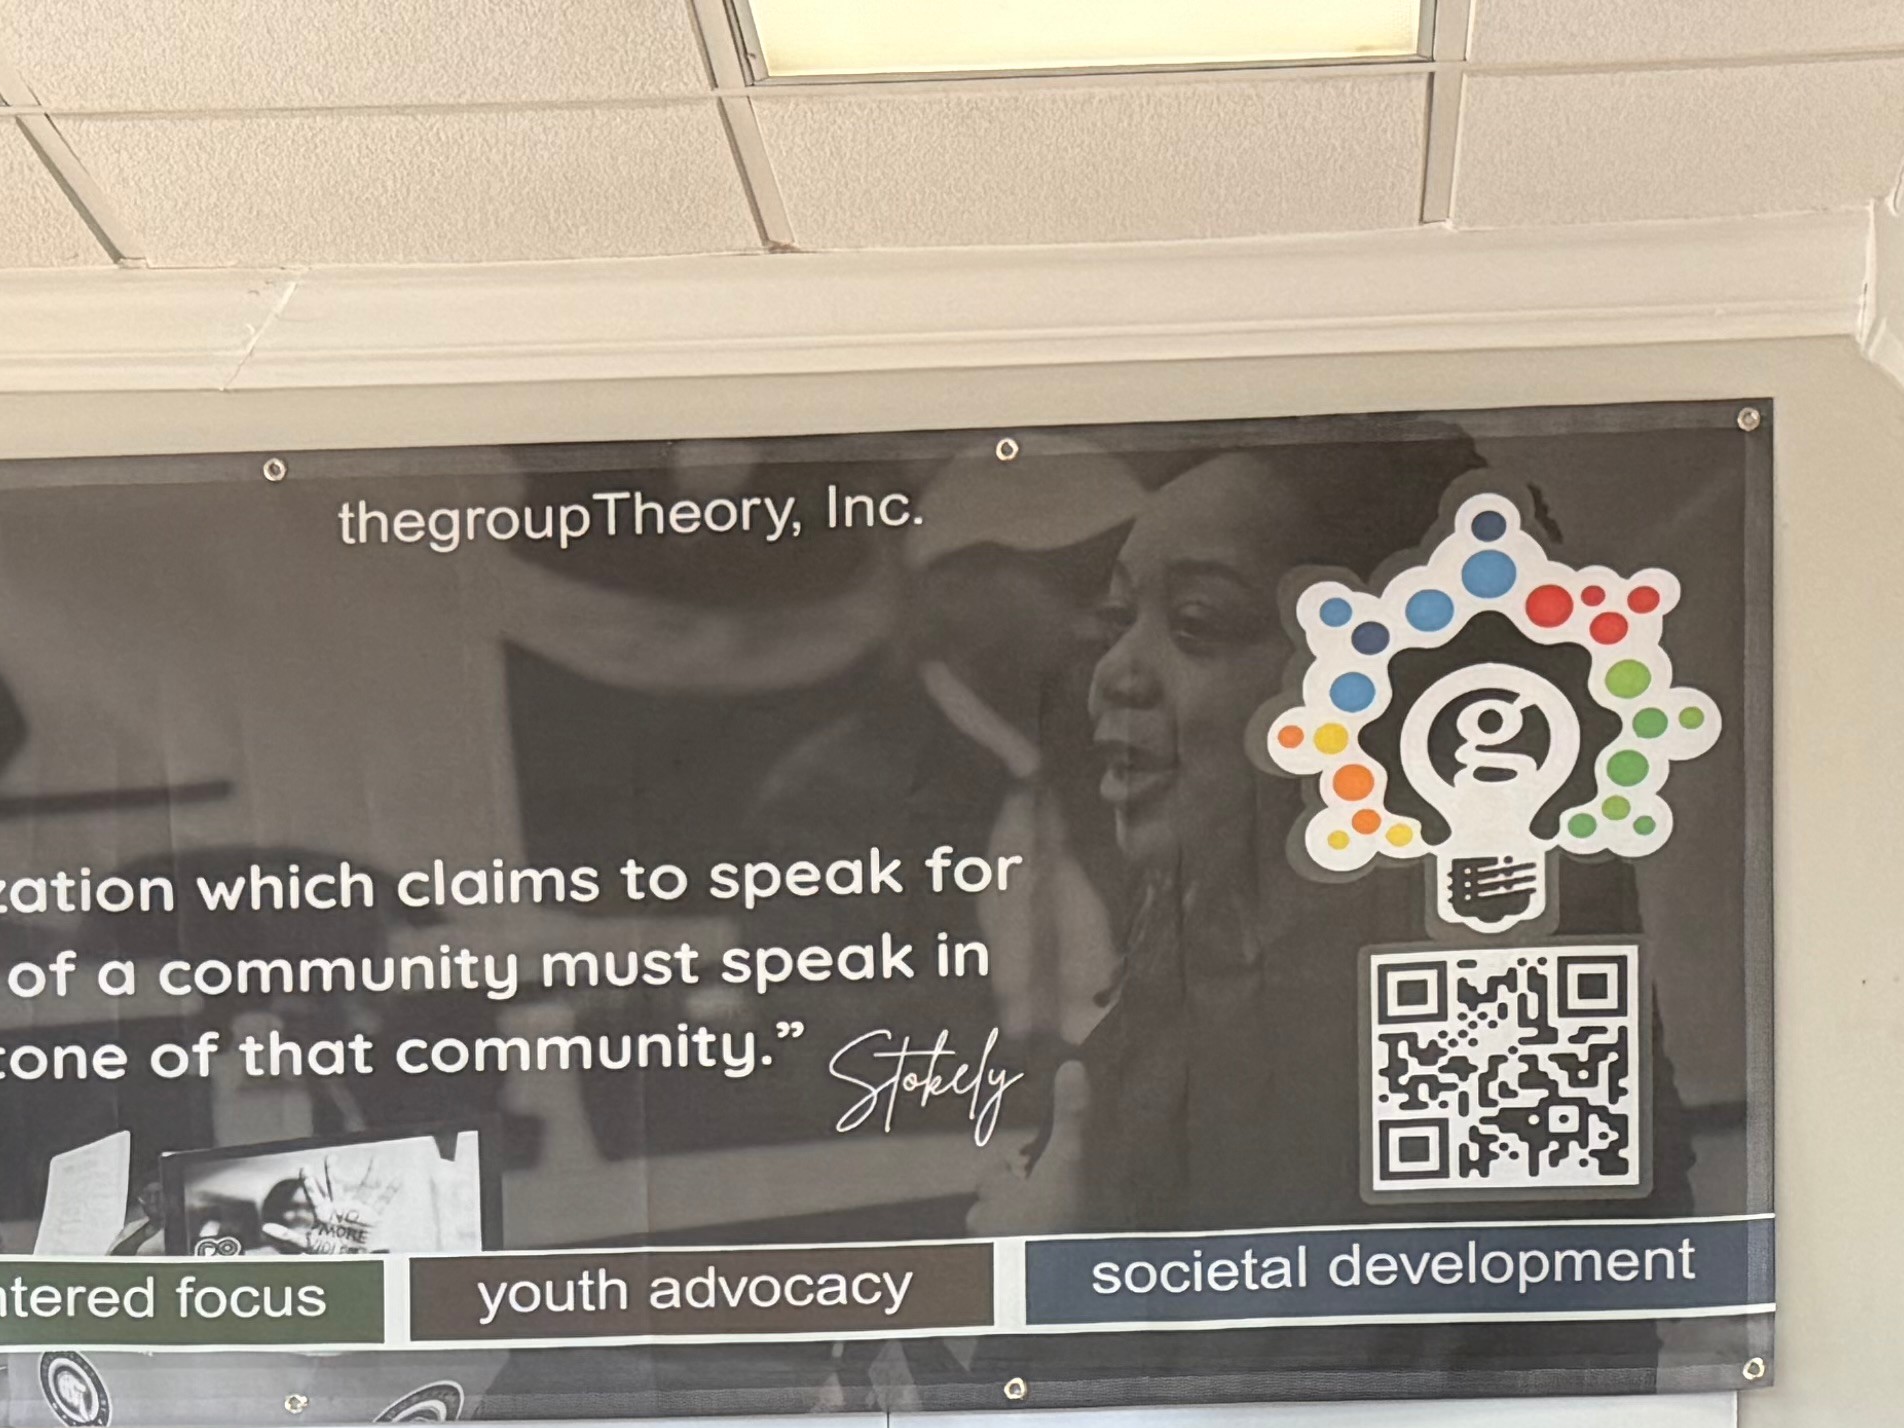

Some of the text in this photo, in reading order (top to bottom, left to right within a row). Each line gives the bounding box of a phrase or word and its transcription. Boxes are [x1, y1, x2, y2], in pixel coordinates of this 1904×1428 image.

[338, 485, 922, 552] thegroupTheory, Inc.
[197, 862, 373, 910] which
[398, 859, 599, 906] claims
[620, 859, 687, 899] to
[710, 847, 903, 909] speak
[925, 846, 1022, 892] for
[8, 950, 76, 997] of
[98, 961, 134, 995] a
[159, 945, 517, 1000] community
[543, 943, 698, 986] must
[722, 932, 914, 994] speak
[938, 932, 988, 976] in
[151, 1032, 219, 1078] of
[239, 1031, 372, 1075] that
[397, 1022, 804, 1077] community.”
[829, 1028, 1024, 1147] Stokely
[478, 1266, 913, 1324] youth advocacy
[1093, 1239, 1695, 1293] societal development
[176, 1276, 326, 1318] focus
